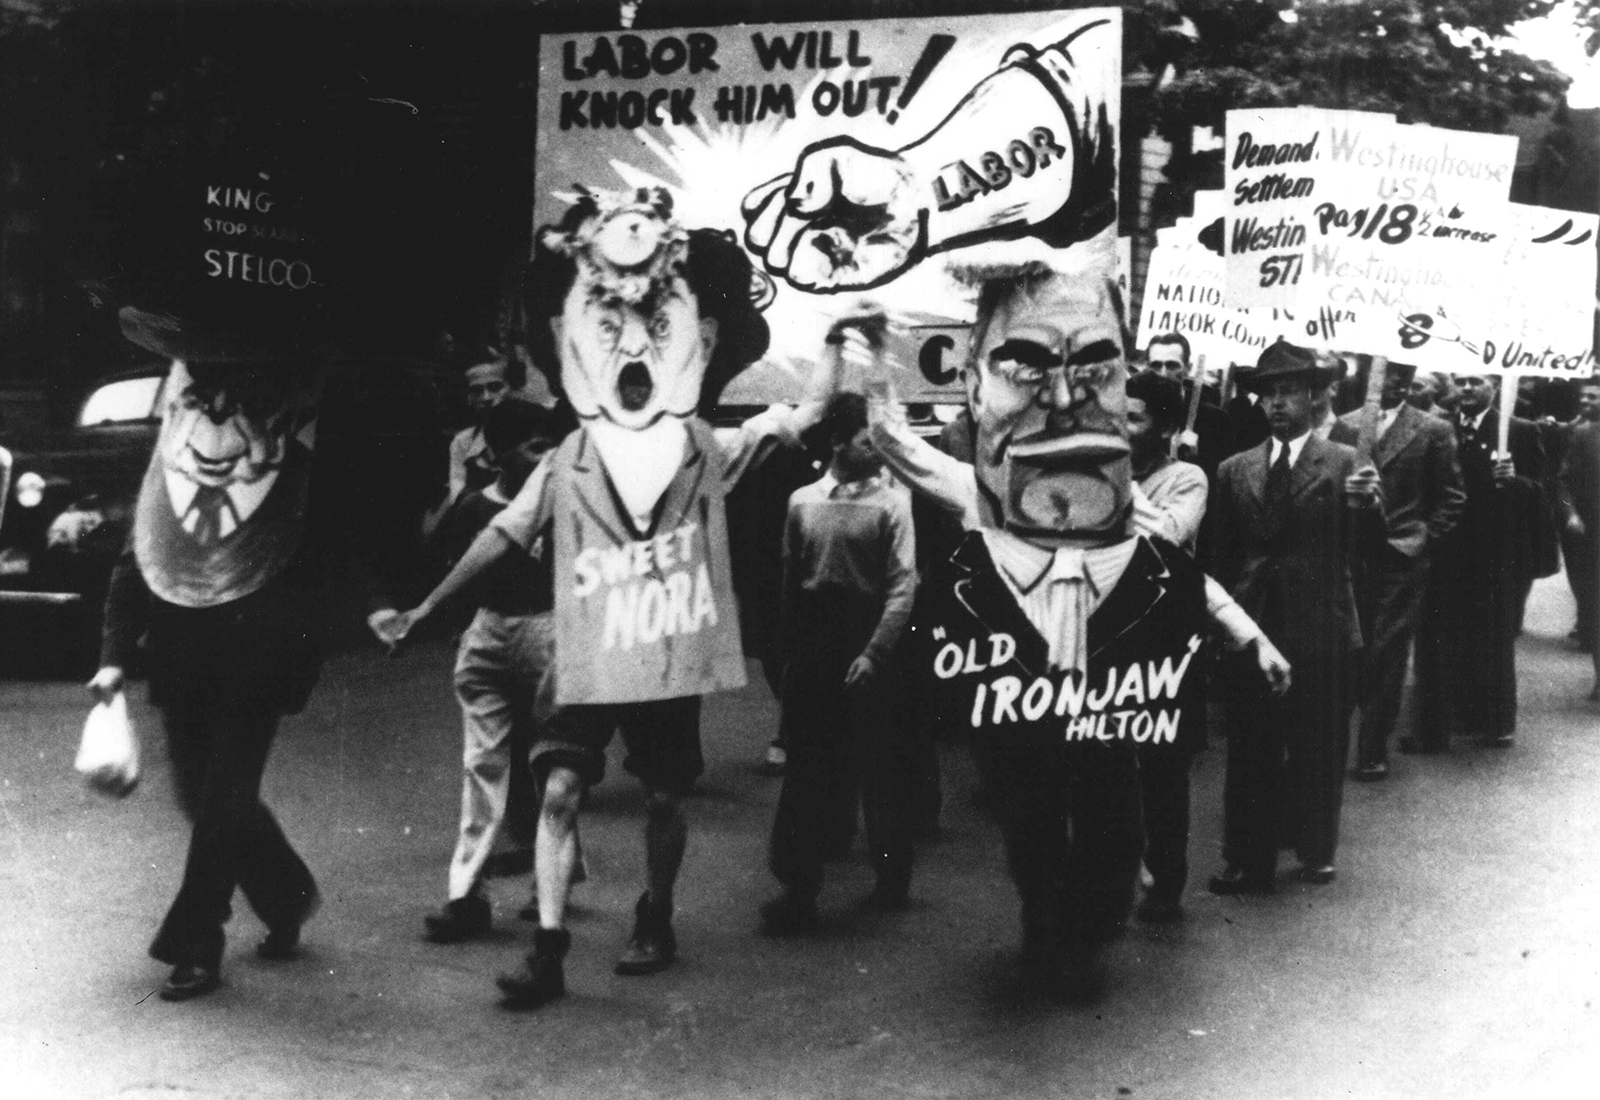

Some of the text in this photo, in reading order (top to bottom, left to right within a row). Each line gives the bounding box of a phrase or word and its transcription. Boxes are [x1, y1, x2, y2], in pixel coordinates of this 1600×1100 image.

[562, 30, 871, 80] LABOR WILL
[560, 34, 957, 130] KNOCK HIM OUT!
[931, 126, 1066, 212] LABOR
[1232, 131, 1320, 170] Demand
[1331, 127, 1508, 182] Westinghouse
[206, 185, 275, 213] KING
[203, 218, 247, 235] STOP
[1231, 215, 1306, 255] Westin
[1314, 202, 1370, 237] Pay
[204, 249, 312, 289] STELCO
[573, 520, 698, 598] SWEET
[604, 562, 718, 651] NORA
[1066, 708, 1181, 744] HILTON
